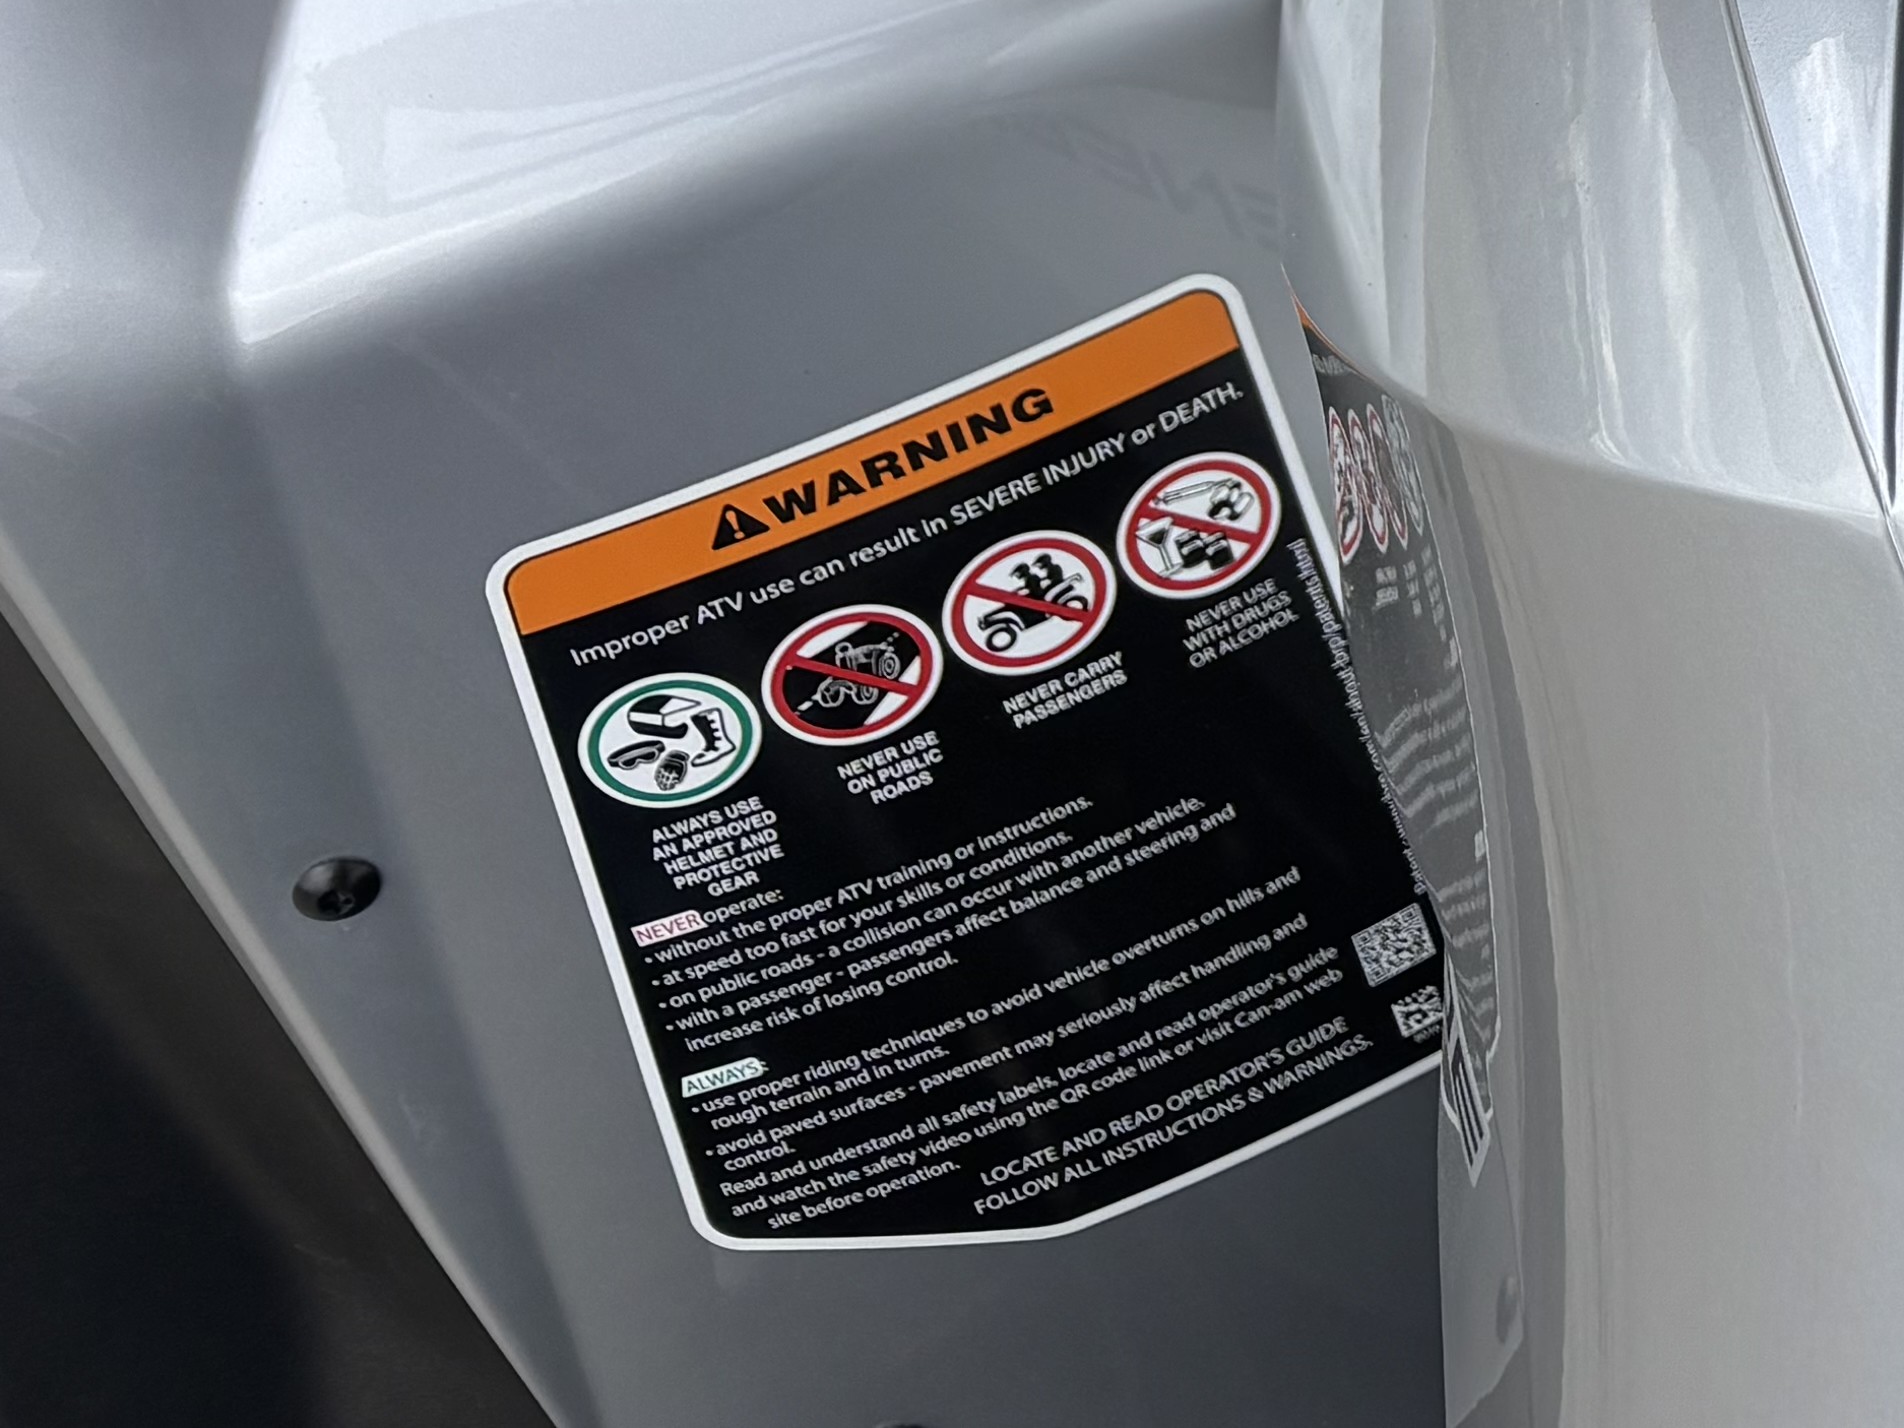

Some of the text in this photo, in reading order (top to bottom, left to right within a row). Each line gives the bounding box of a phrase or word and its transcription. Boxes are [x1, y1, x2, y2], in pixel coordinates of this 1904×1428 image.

[762, 388, 1053, 526] WARNING
[569, 381, 1243, 665] Improper ATV use can result in SEVERE INJURY or DEATH.
[1002, 651, 1121, 713] NEVER CARRY
[1012, 669, 1127, 728] PASSENGERS
[836, 730, 938, 779] NEVER USE
[847, 748, 943, 793] ON PUBLIC
[869, 770, 933, 804] ROADS
